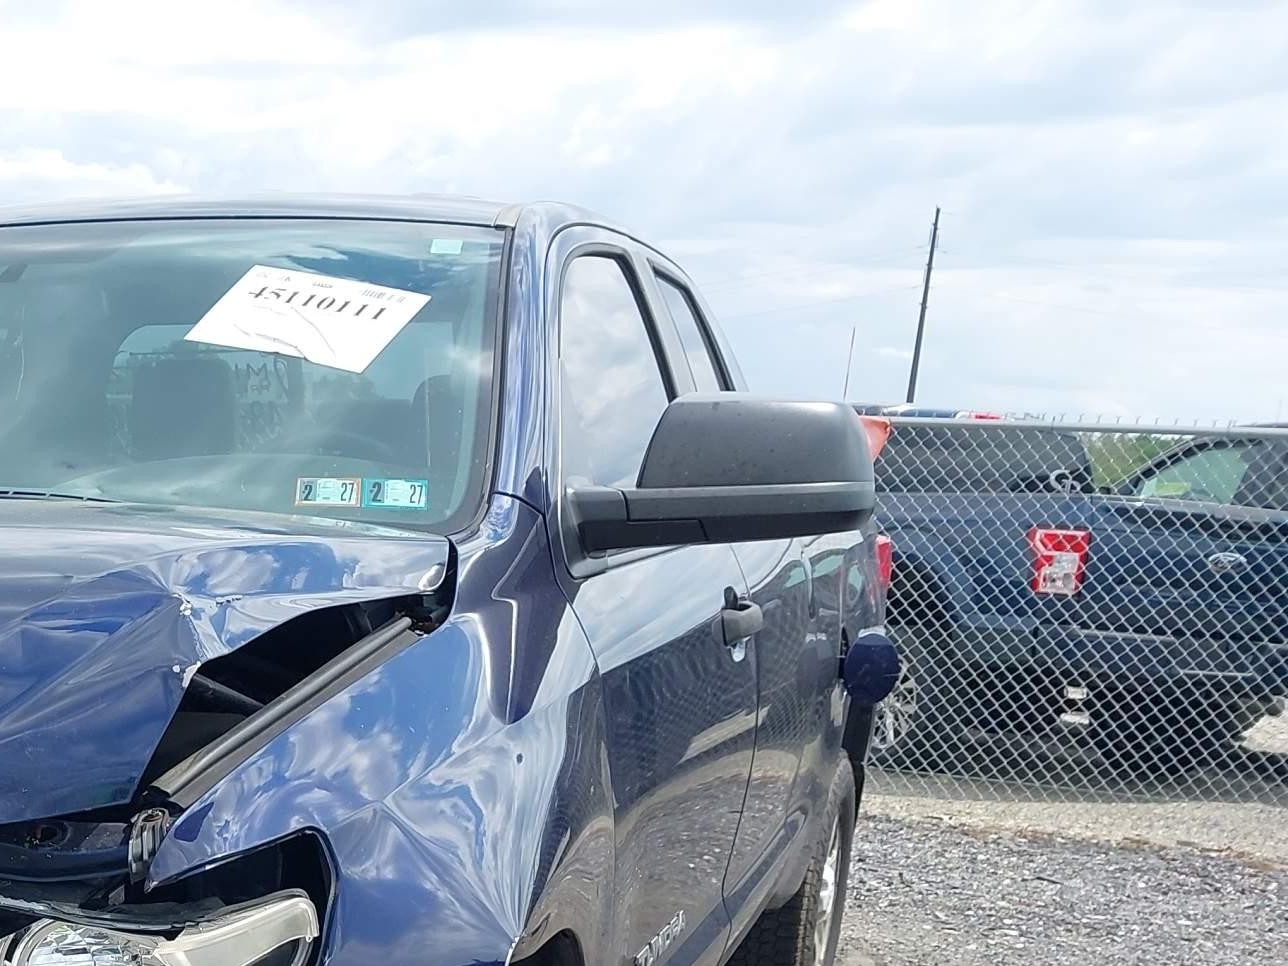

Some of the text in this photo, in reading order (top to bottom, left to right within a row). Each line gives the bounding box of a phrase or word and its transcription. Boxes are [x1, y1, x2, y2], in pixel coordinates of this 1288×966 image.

[247, 285, 388, 321] 45110111
[340, 482, 355, 504] 27
[409, 484, 424, 505] 27
